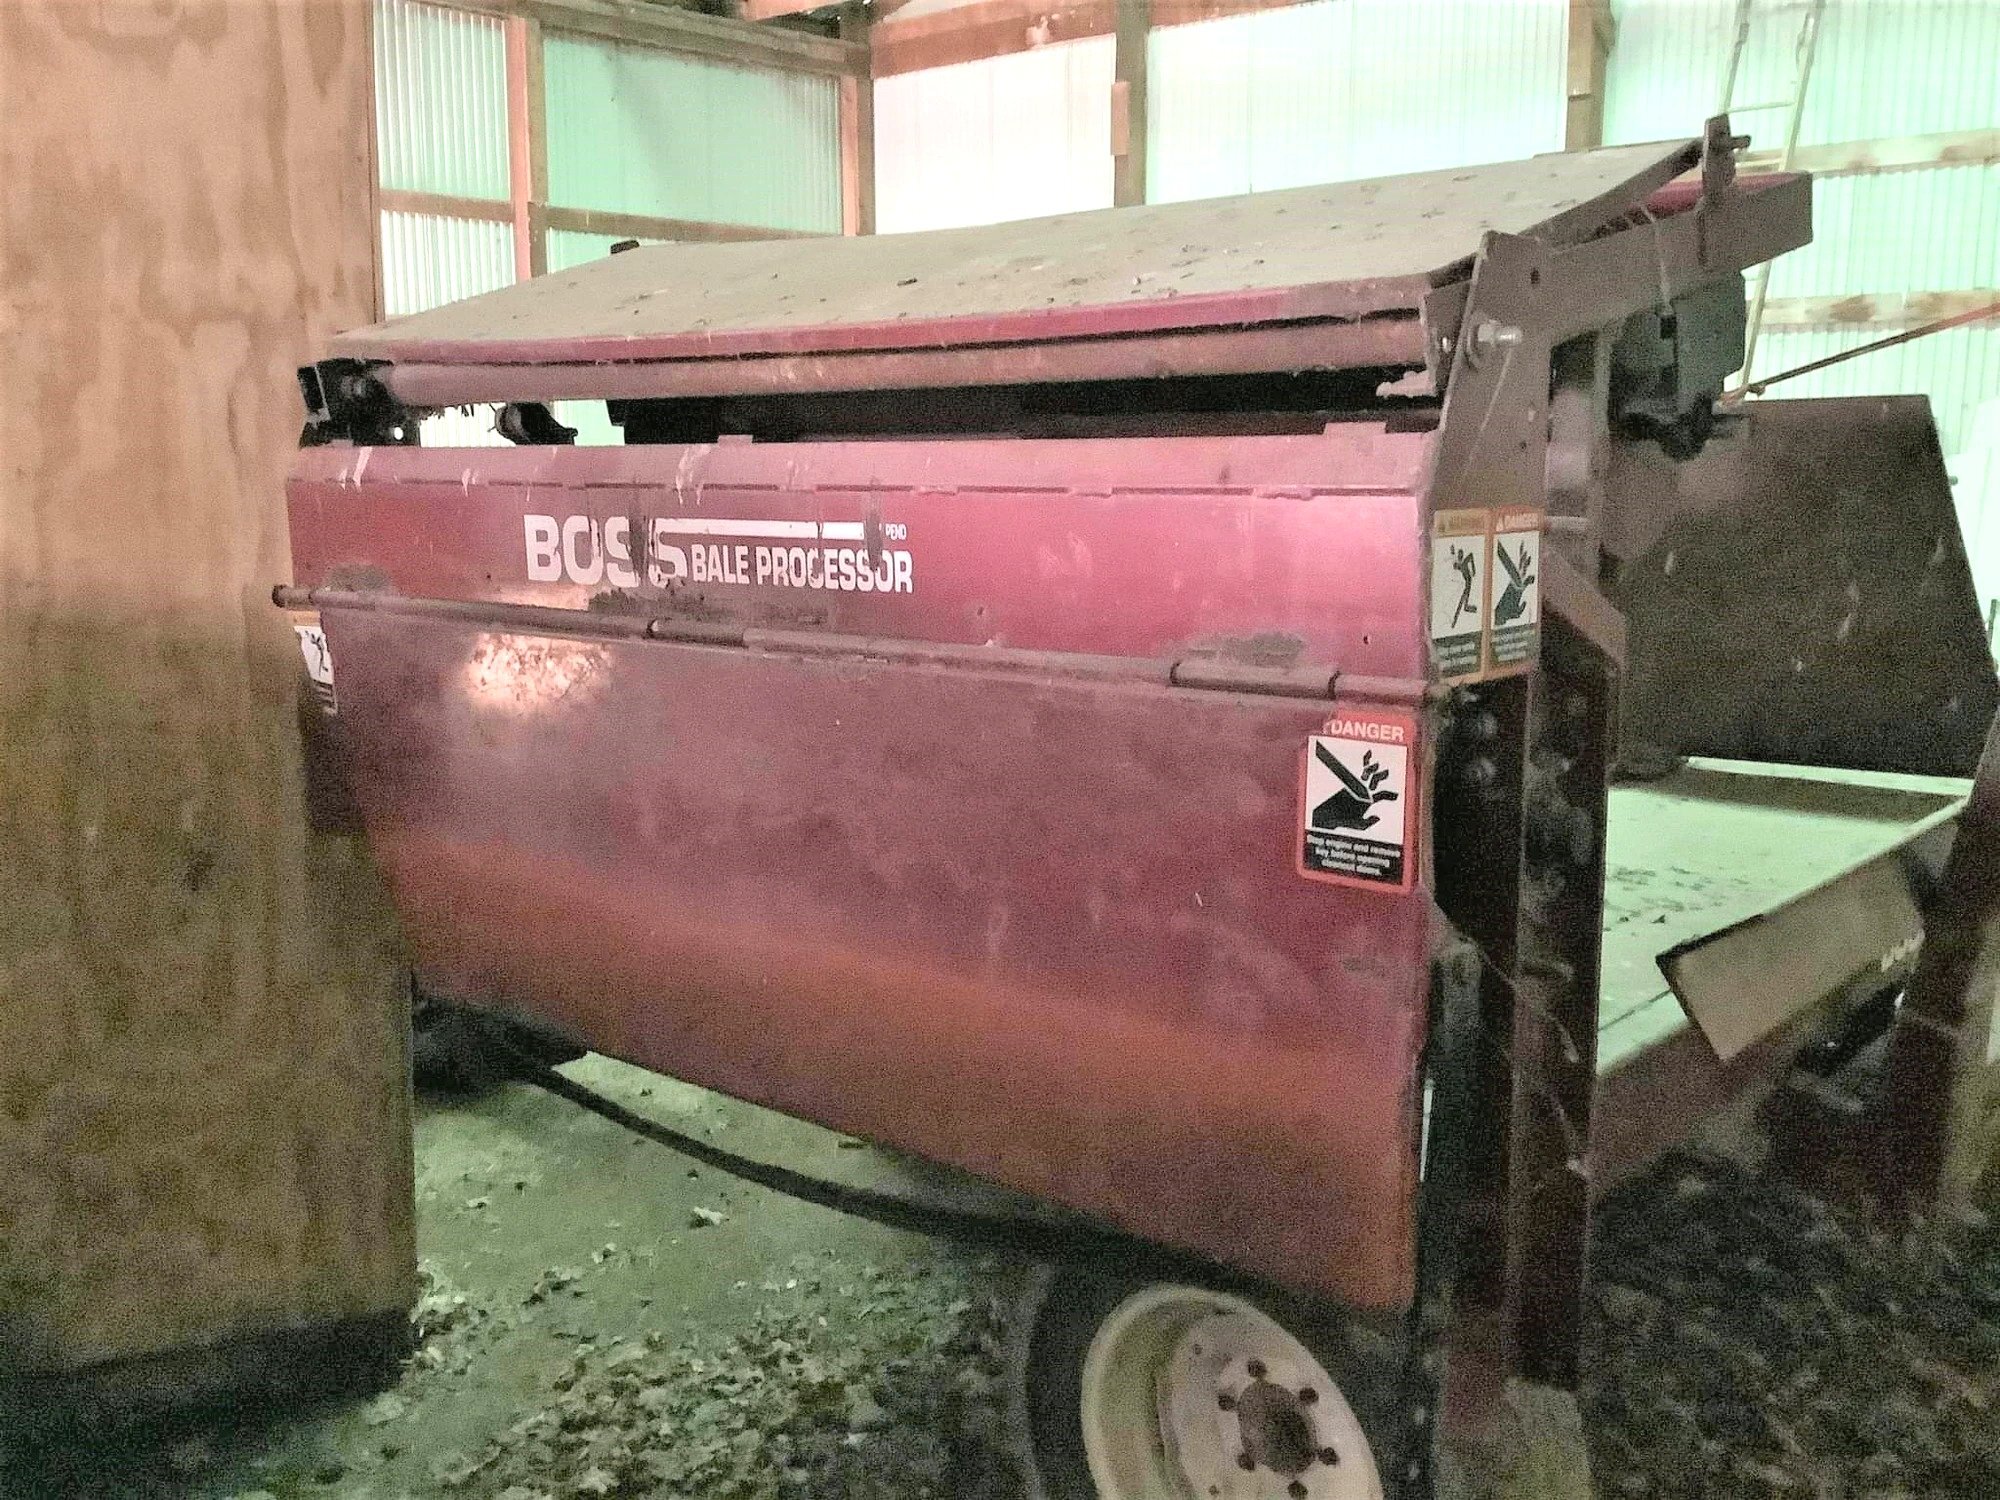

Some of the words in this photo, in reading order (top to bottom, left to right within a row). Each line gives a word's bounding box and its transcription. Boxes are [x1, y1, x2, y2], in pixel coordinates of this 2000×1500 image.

[523, 514, 688, 588] BOSS
[692, 544, 750, 585] BALE
[757, 546, 913, 594] PROCESSOR
[1331, 719, 1404, 742] DANGER
